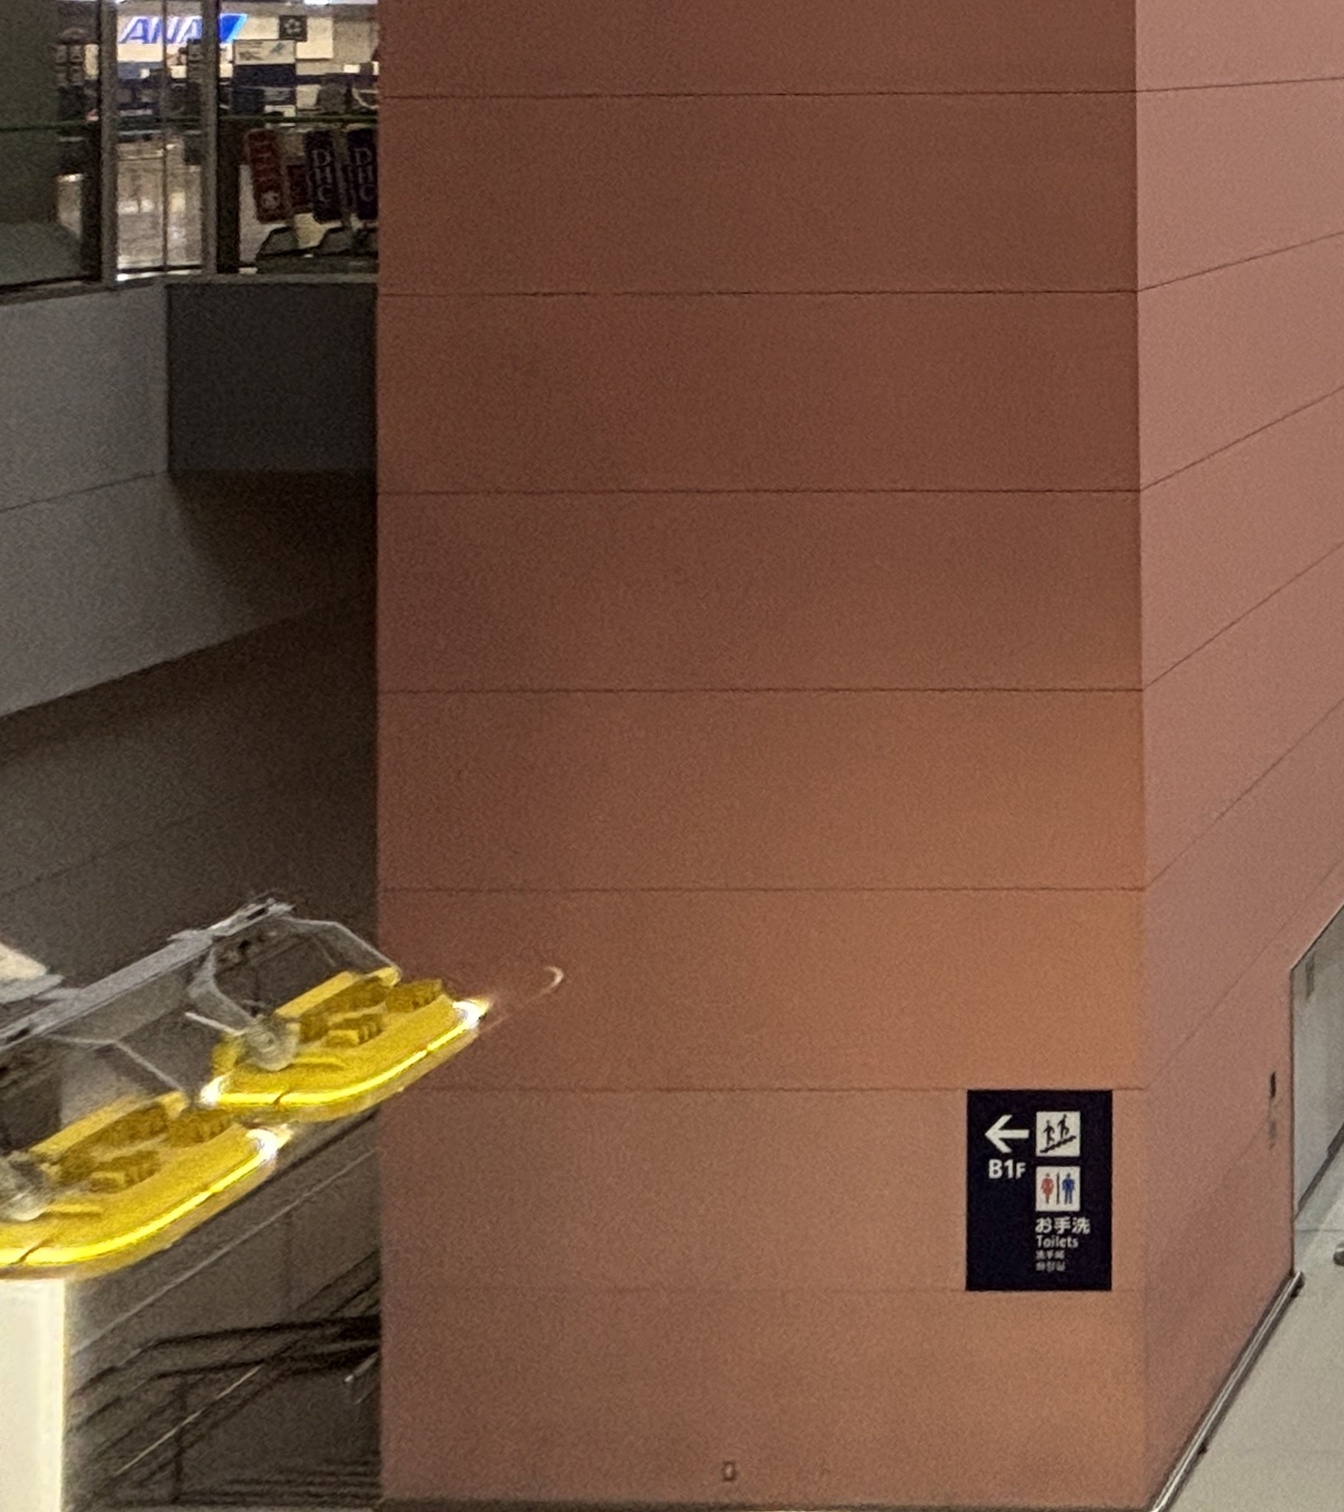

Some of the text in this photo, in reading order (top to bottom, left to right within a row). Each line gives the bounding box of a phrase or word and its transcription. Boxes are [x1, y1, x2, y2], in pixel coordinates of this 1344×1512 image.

[119, 15, 203, 44] ANA
[311, 148, 334, 203] DHC
[988, 1158, 1026, 1179] B1F
[1035, 1216, 1091, 1235] お手洗
[1036, 1235, 1079, 1249] Toilets
